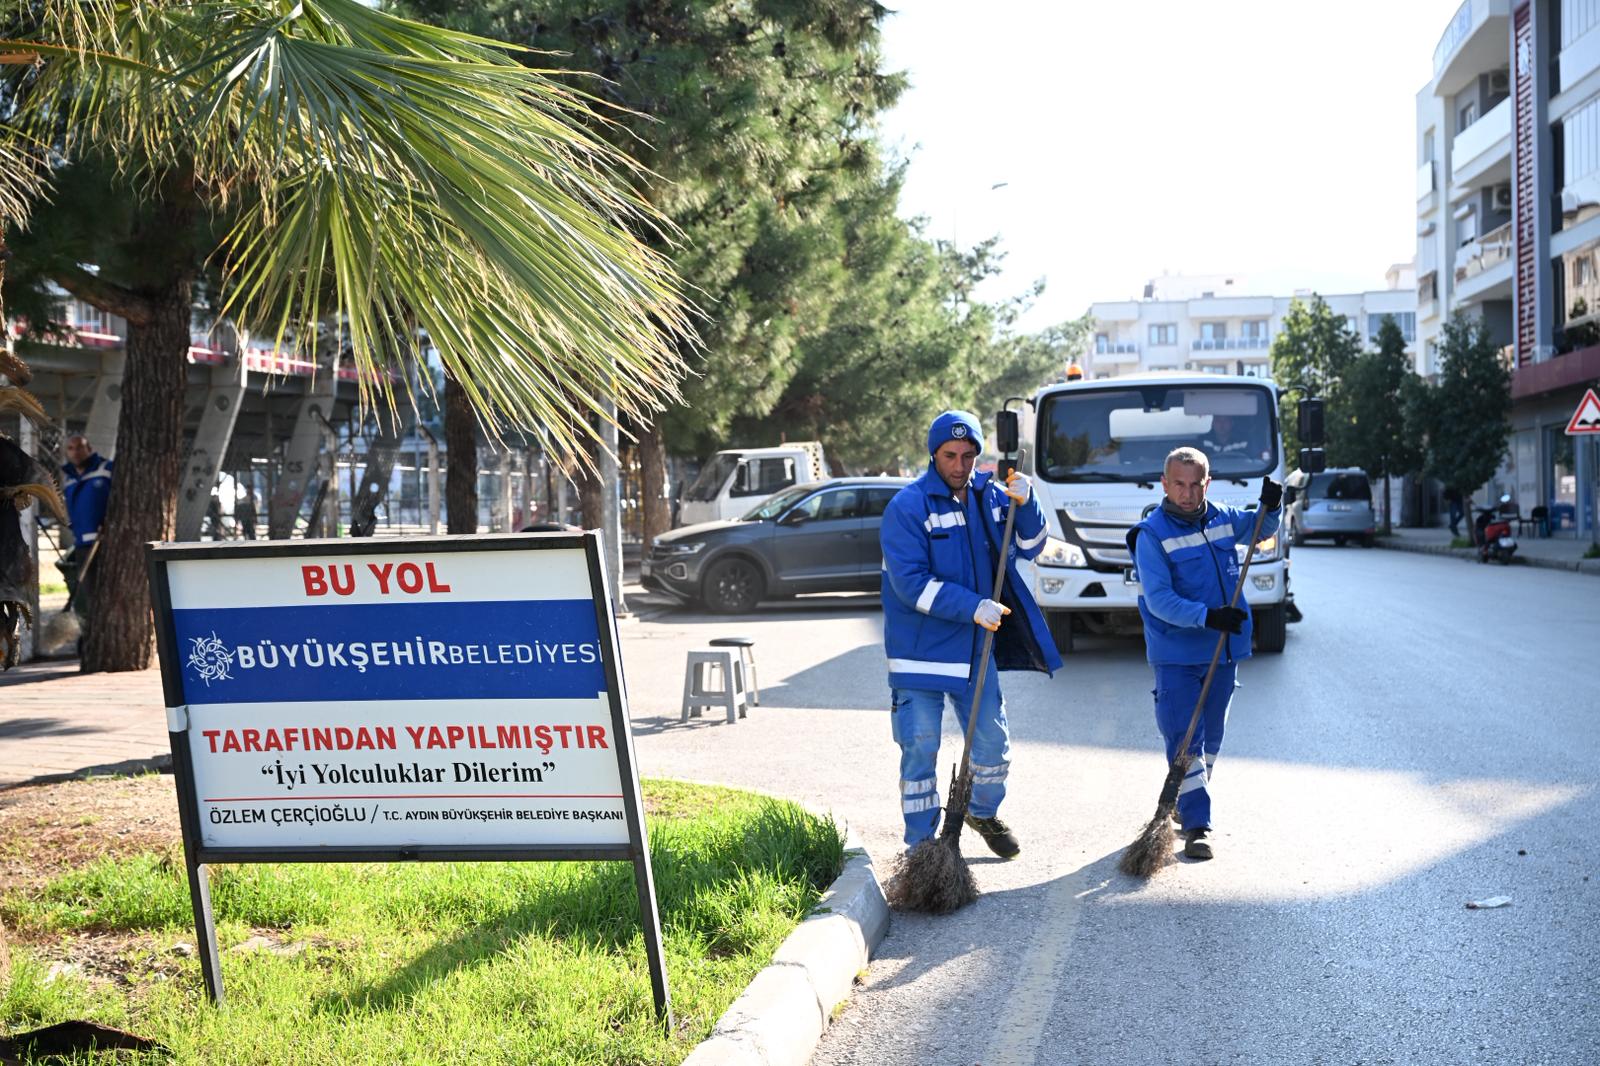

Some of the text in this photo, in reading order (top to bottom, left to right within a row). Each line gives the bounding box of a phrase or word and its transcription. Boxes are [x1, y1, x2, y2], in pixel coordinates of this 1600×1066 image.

[301, 562, 451, 597] BU YOL
[202, 725, 609, 755] TARAFINDAN YAPILMIŞTIR
[311, 762, 446, 786] Yolculuklar
[452, 761, 556, 784] Dilerim”
[209, 807, 266, 824] ÖZLEM
[271, 804, 366, 827] ÇERÇİOĞLU
[383, 811, 402, 821] T.C.
[405, 811, 439, 820] AYDIN
[442, 808, 513, 823] BÜYÜKŞEHİR
[516, 808, 570, 819] BELEDİYE
[573, 810, 623, 822] BAŞKANI
